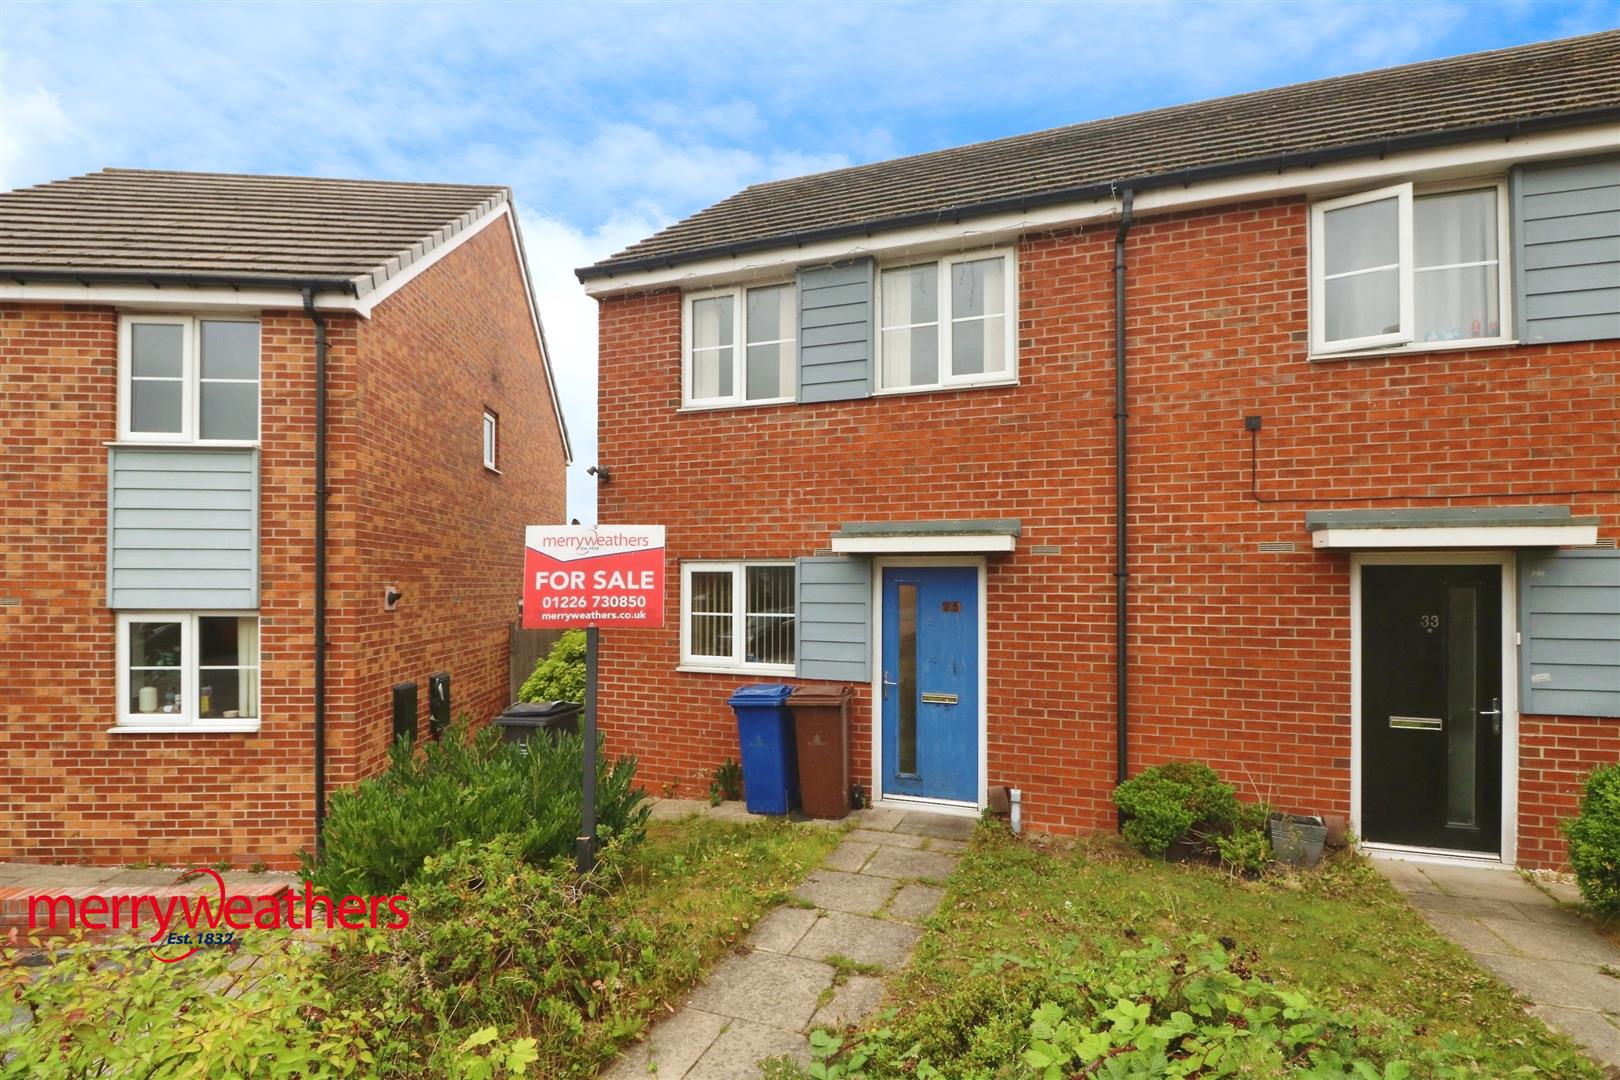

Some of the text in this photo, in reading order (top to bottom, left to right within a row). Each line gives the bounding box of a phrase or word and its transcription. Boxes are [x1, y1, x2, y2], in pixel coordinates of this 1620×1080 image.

[543, 530, 649, 551] merryweathers
[535, 570, 655, 590] FOR SALE
[542, 596, 646, 609] 01226 730850
[542, 610, 646, 621] merryweathers.co.uk
[1420, 615, 1439, 628] 33
